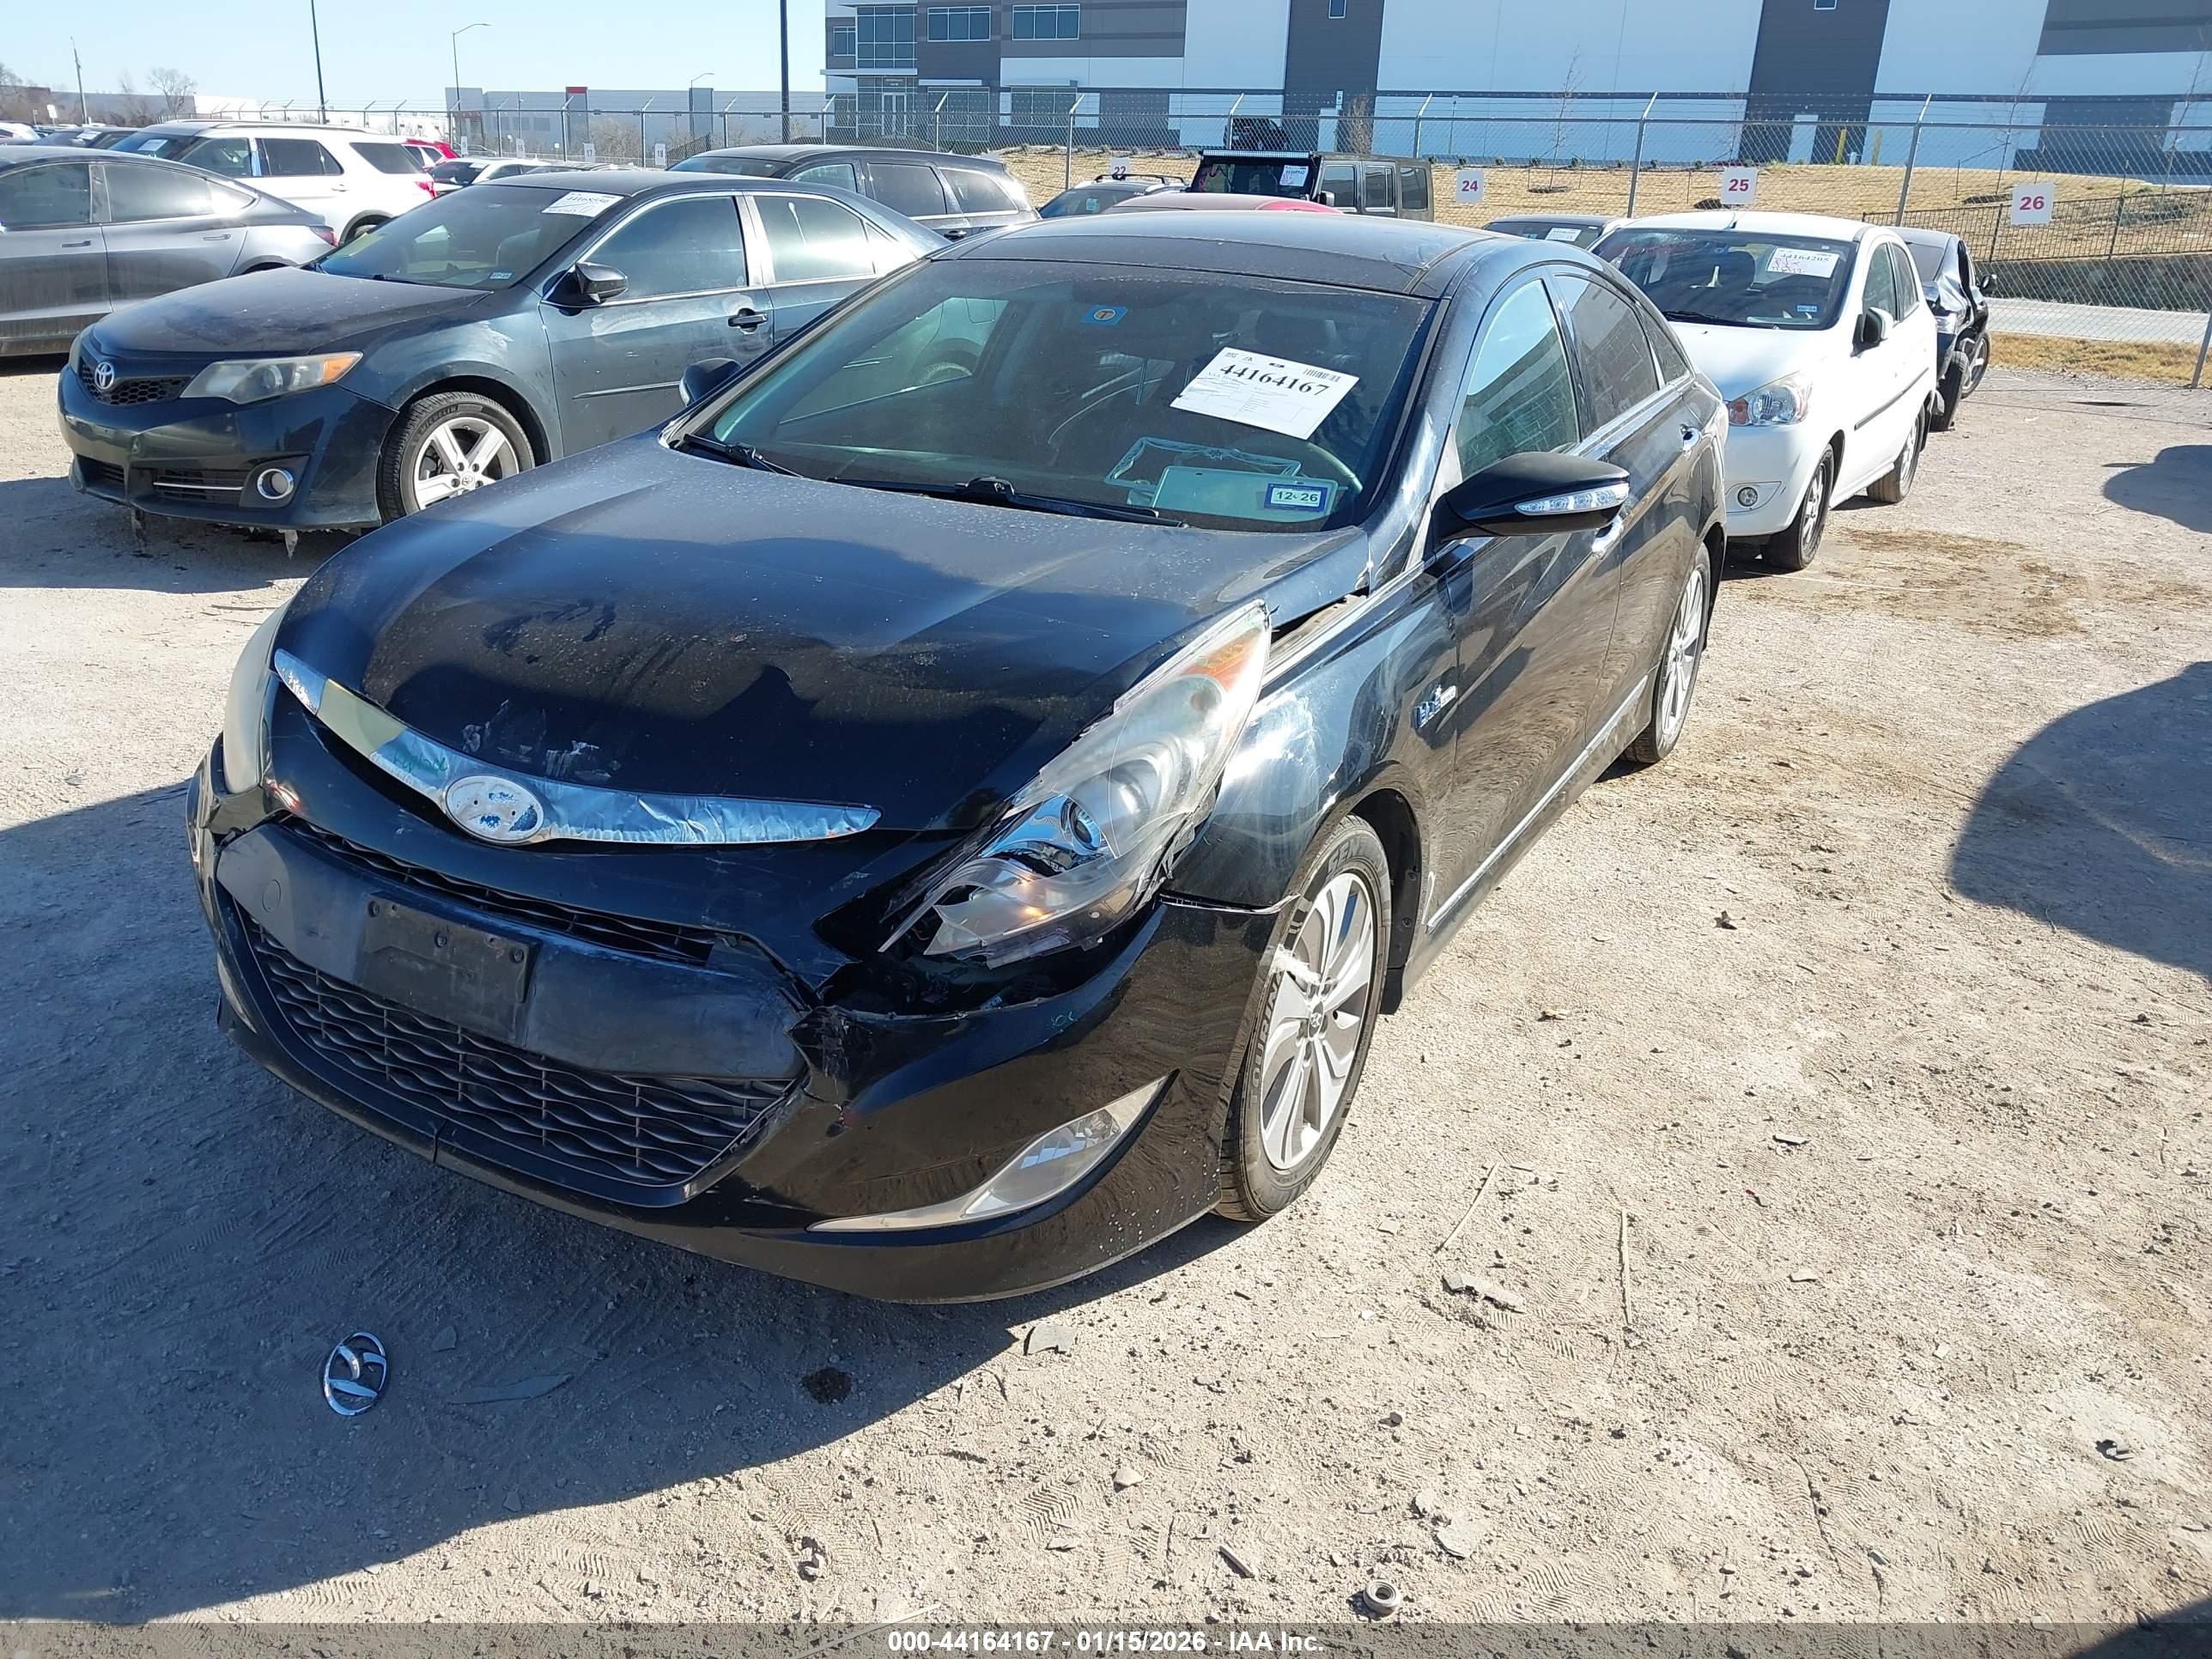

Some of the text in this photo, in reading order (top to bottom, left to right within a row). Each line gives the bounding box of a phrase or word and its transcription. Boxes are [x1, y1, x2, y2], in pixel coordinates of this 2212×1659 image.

[1114, 166, 1126, 176] 22
[1462, 180, 1478, 191] 24
[1729, 179, 1749, 191] 25
[2020, 196, 2045, 210] 26
[1219, 364, 1330, 396] 44164167
[1277, 491, 1319, 502] 12 26
